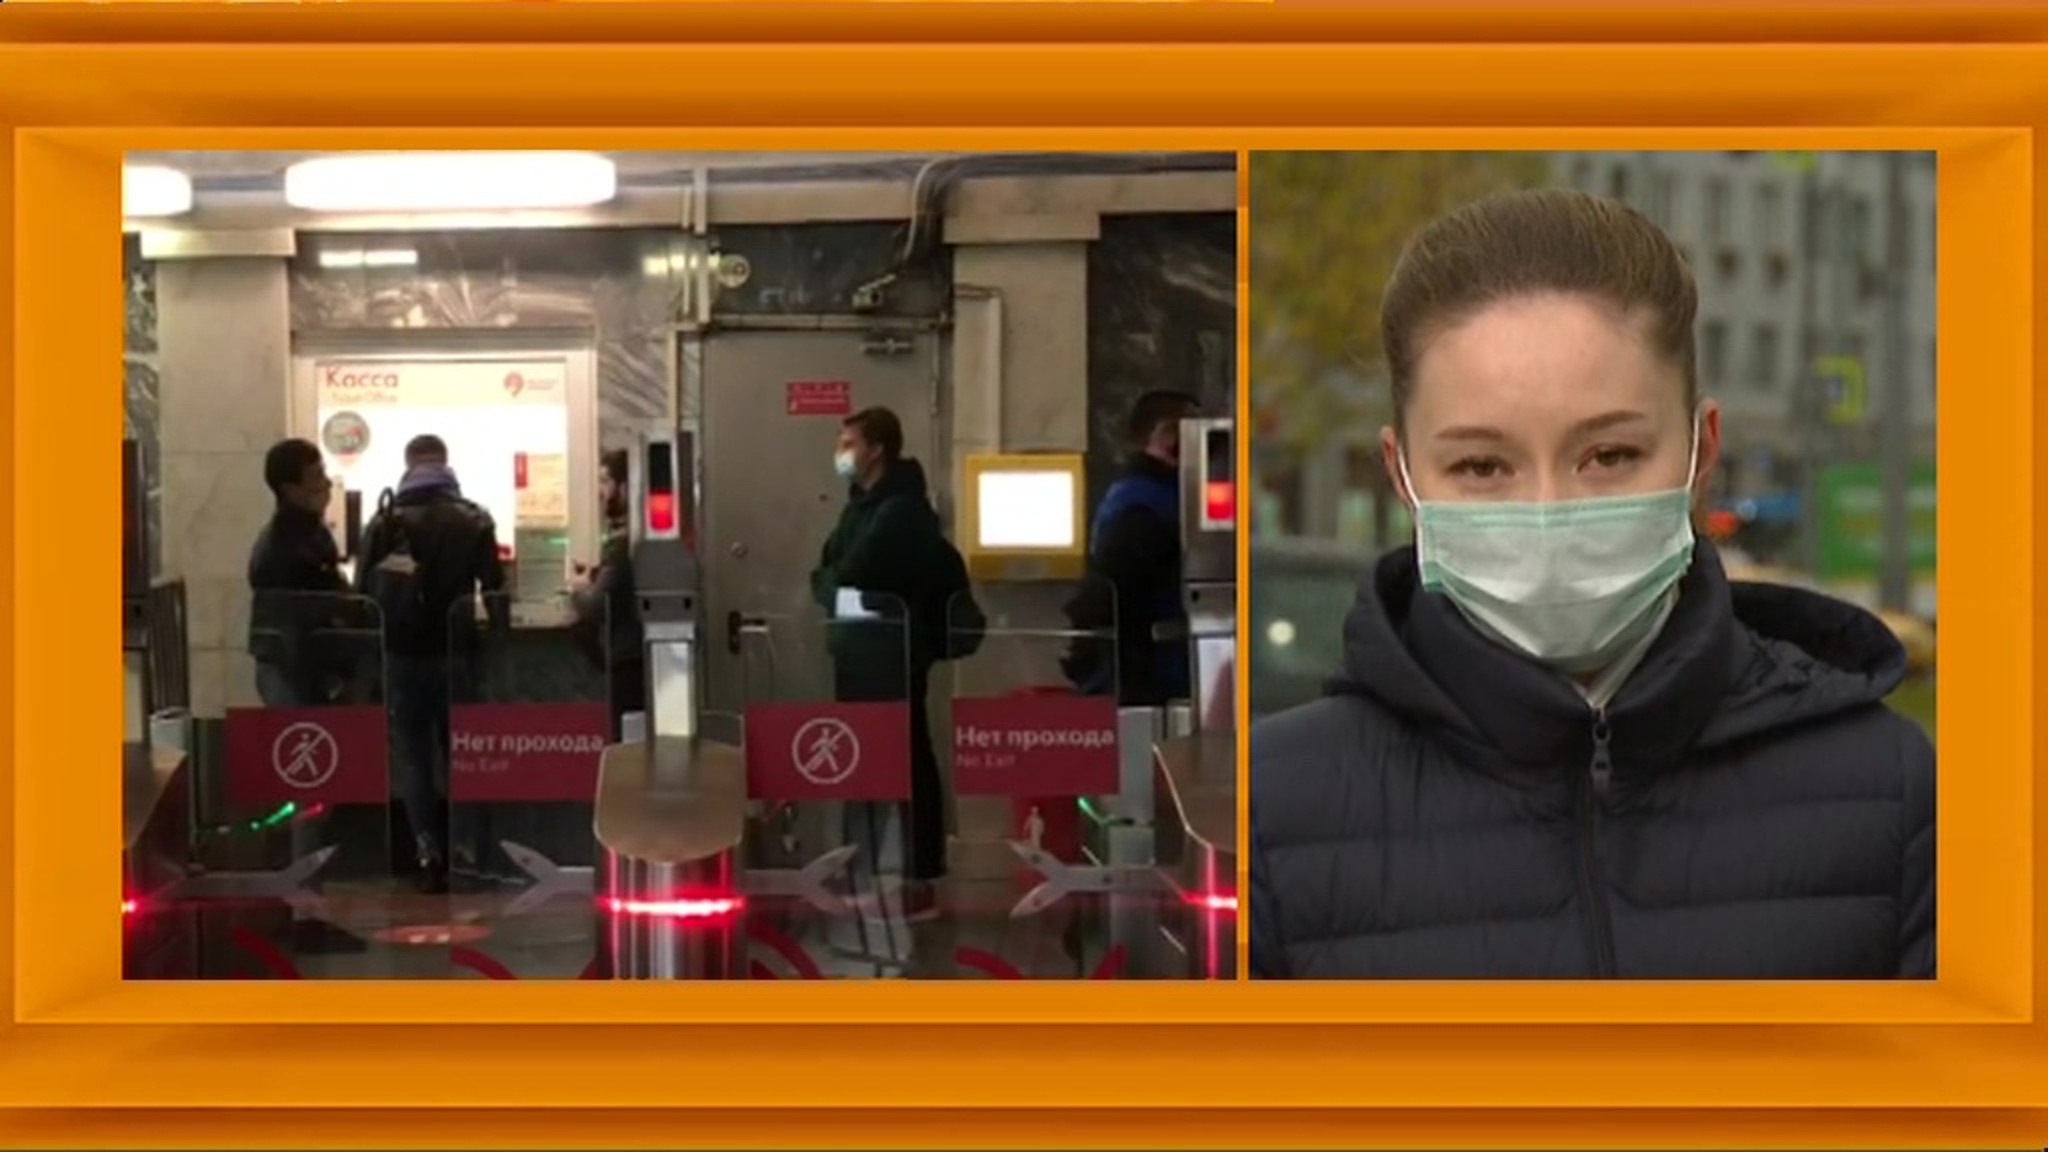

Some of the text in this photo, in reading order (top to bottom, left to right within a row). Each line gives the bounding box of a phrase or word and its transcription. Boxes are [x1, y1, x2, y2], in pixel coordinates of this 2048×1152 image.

[326, 366, 399, 389] Касса
[452, 731, 604, 757] Нет прохода
[954, 725, 1115, 751] Нет прохода
